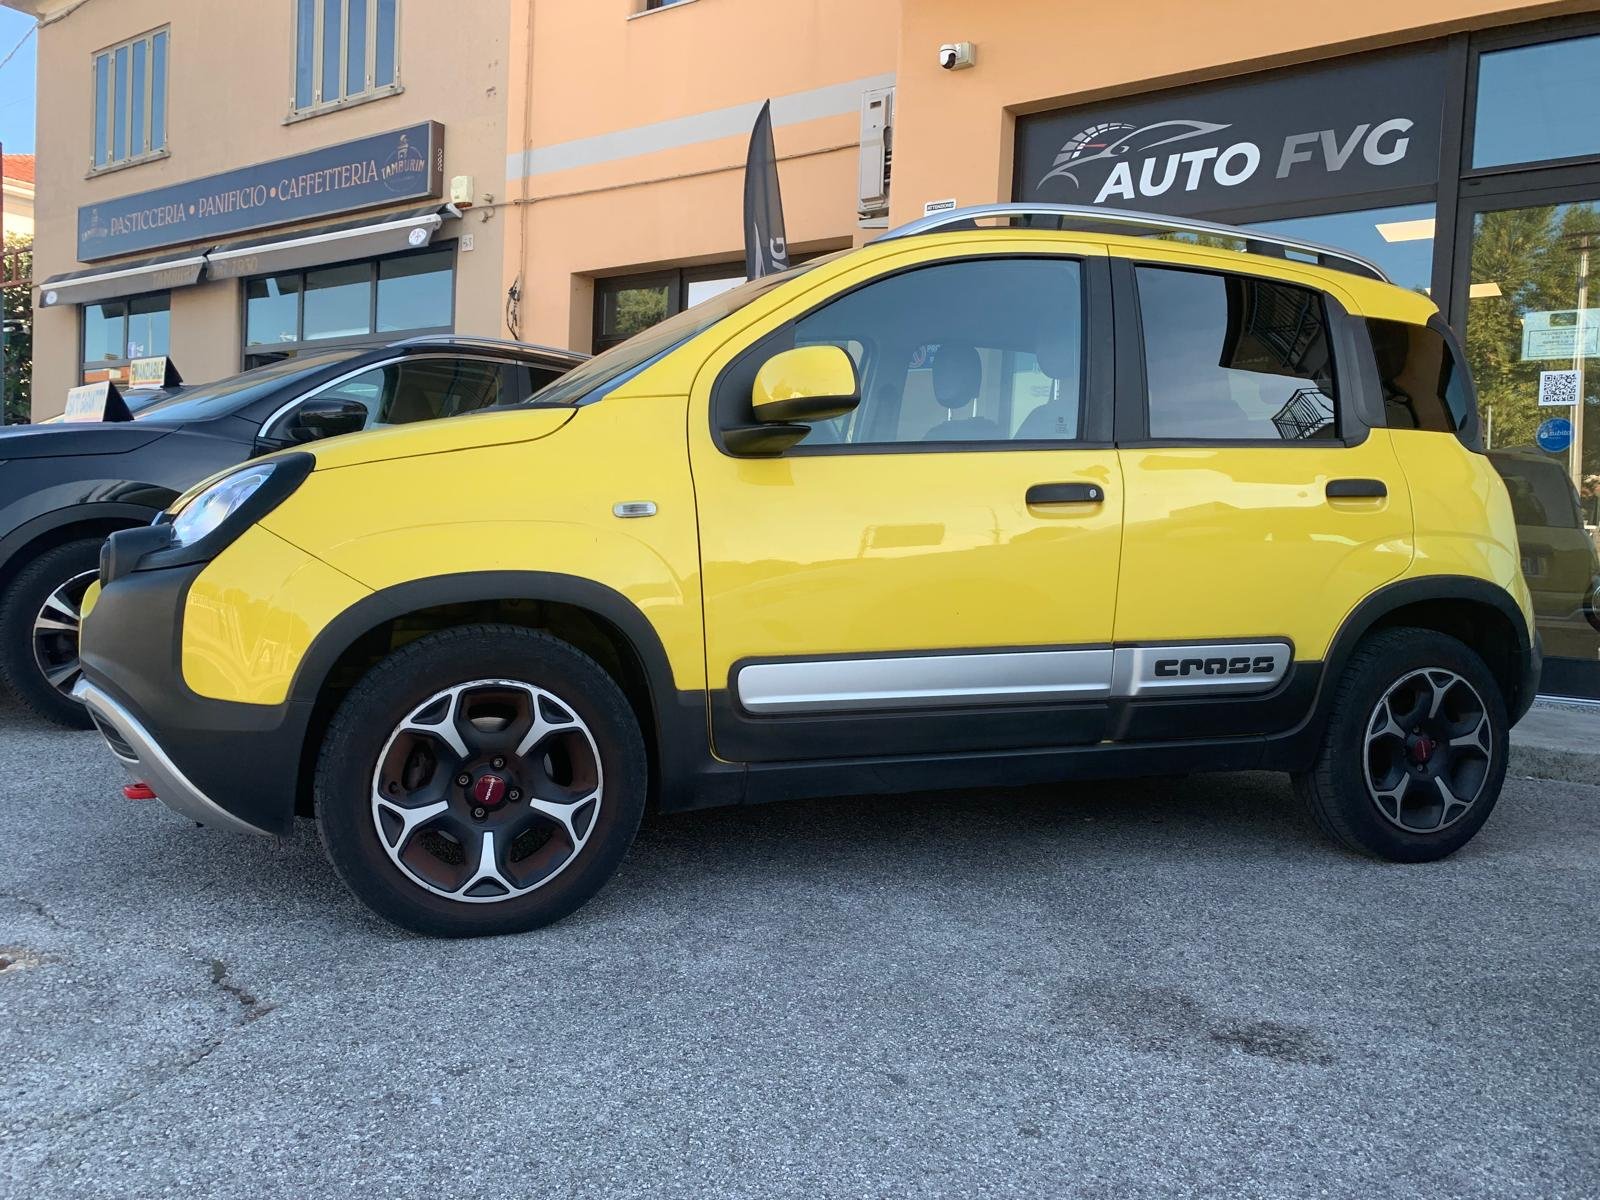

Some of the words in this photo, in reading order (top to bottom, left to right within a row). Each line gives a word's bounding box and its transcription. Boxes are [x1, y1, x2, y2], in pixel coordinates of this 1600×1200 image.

[110, 203, 187, 236] PASTICCERIA
[198, 184, 267, 218] PANIFICIO
[278, 160, 378, 202] CAFFETTERIA
[381, 159, 425, 180] TAMBURIN
[1093, 141, 1260, 204] AUTO
[1275, 117, 1414, 180] FVG
